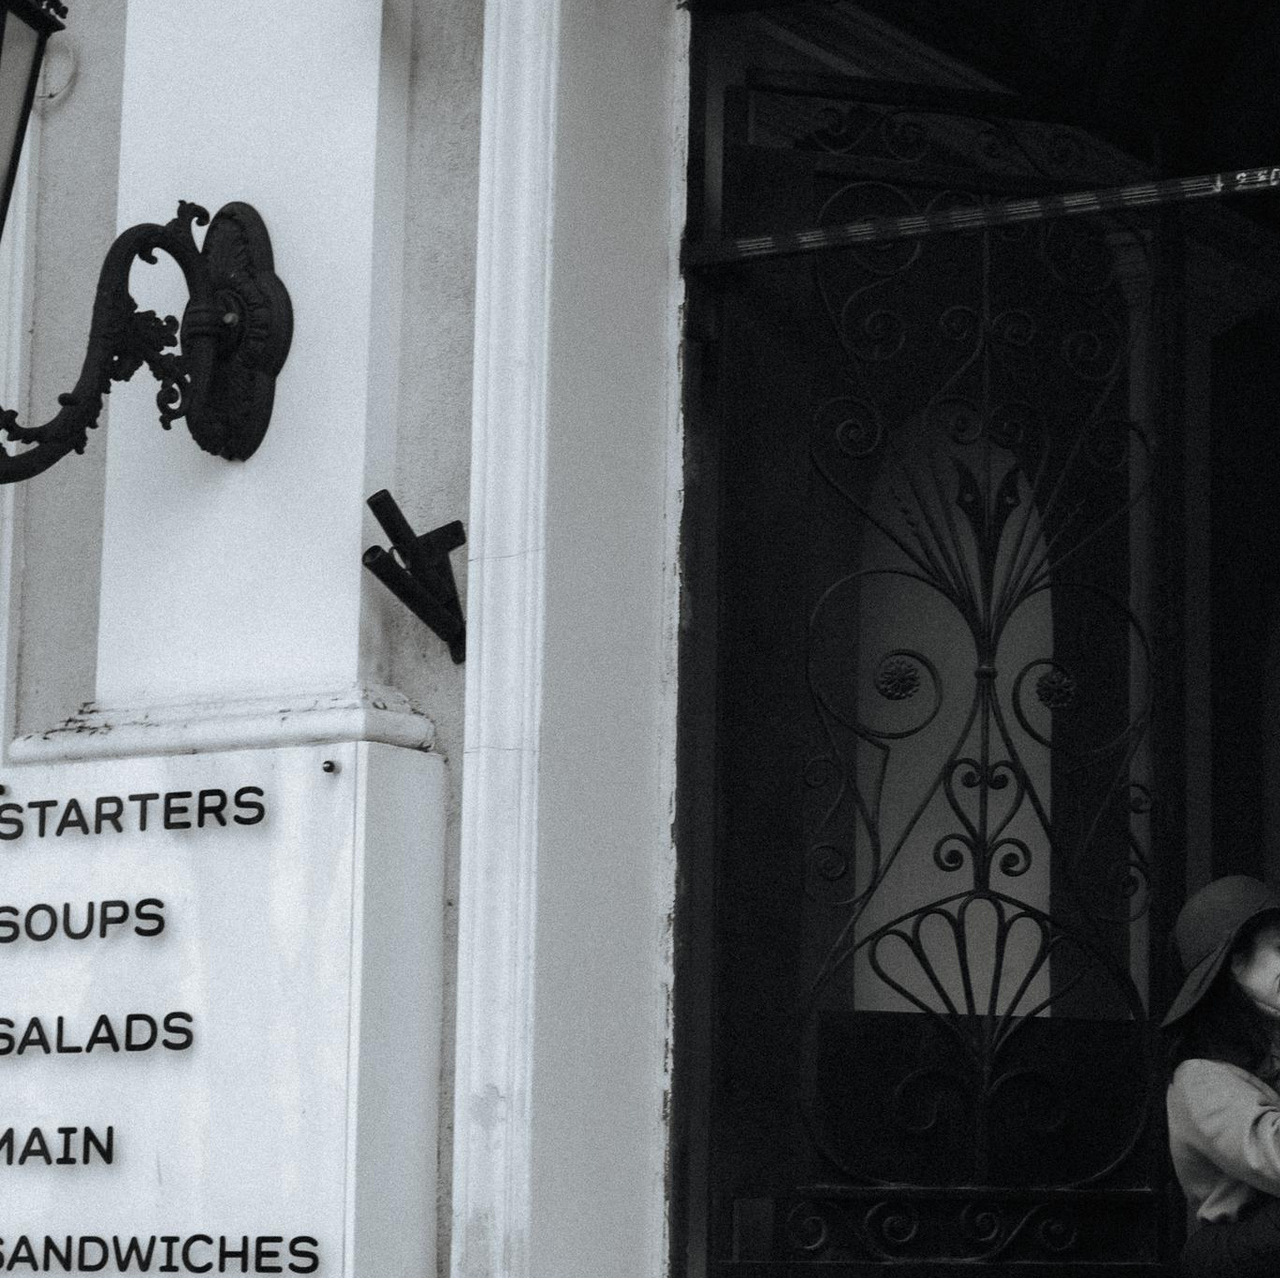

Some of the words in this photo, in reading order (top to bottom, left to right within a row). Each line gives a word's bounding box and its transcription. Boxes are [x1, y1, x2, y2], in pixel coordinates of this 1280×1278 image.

[0, 786, 265, 840] STARTERS
[0, 898, 165, 944] SOUPS
[0, 1234, 319, 1274] ANDWICHES
